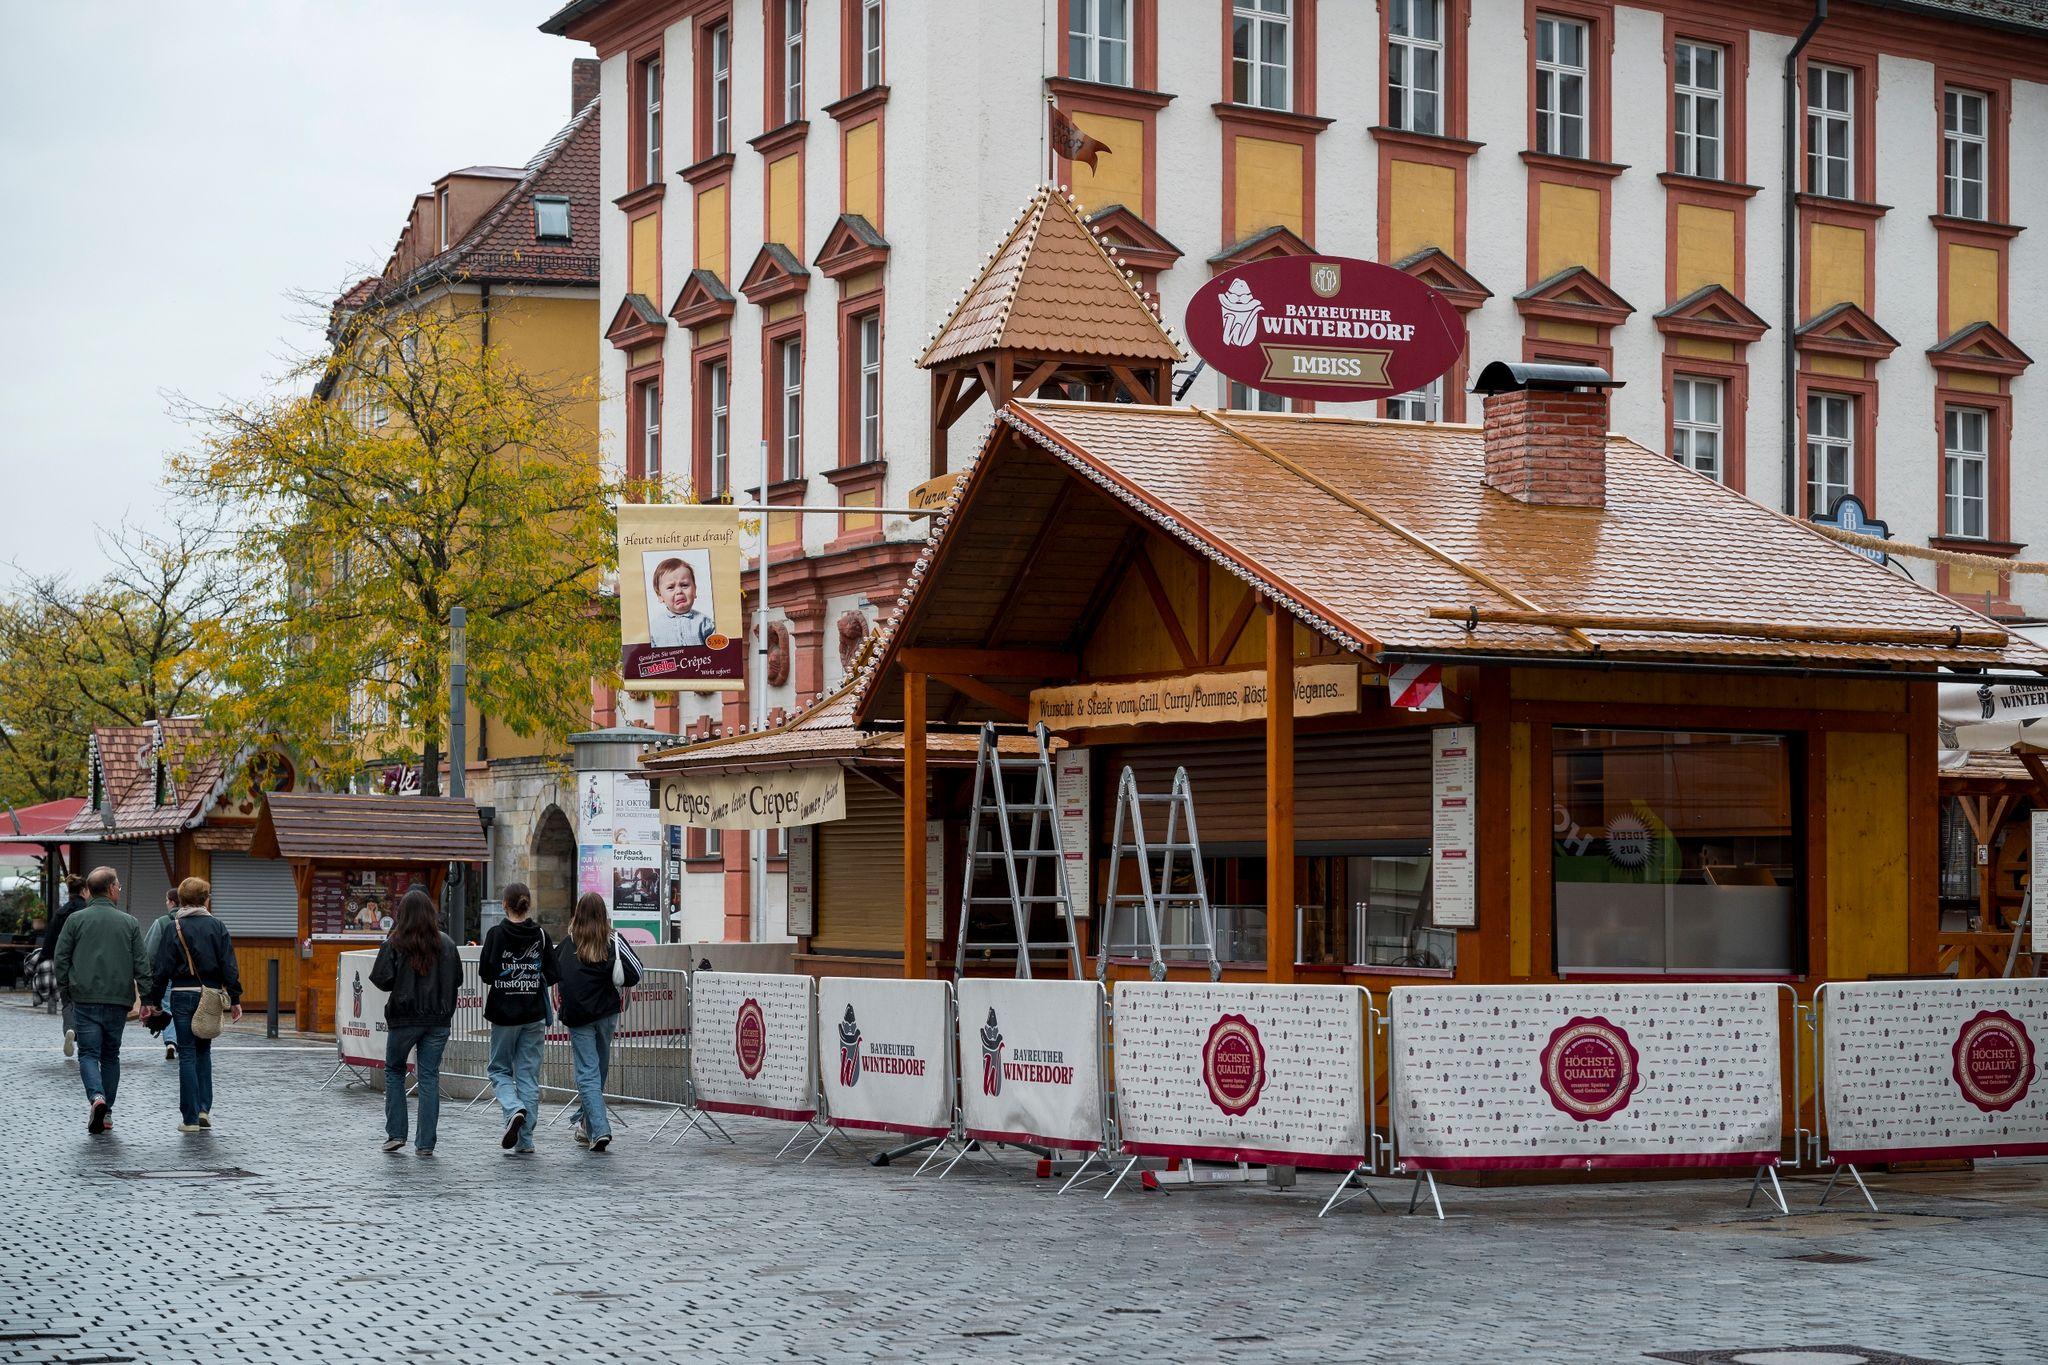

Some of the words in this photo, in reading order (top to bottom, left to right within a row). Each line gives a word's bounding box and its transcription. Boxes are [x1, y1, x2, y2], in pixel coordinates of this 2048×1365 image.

[1285, 304, 1391, 322] BAYREUTHER
[1261, 316, 1416, 341] WINTERDORF
[1292, 356, 1361, 377] IMBISS
[624, 532, 653, 545] Heute
[656, 530, 680, 544] nicht
[683, 533, 701, 547] gut
[702, 529, 734, 545] drauf?
[1040, 701, 1074, 717] Wurscht
[1077, 699, 1084, 715] &
[1087, 697, 1113, 716] Steak
[1116, 699, 1136, 714] vom
[1138, 693, 1161, 712] Grill,
[1164, 690, 1240, 713] Curry/Pommes,
[665, 784, 710, 823] Crêpes
[750, 785, 799, 824] Crêpes
[501, 960, 538, 970] Universe
[870, 1043, 915, 1056] BAYREUTHER
[1013, 1049, 1064, 1063] BAYREUTHER
[1972, 1047, 2015, 1059] HÖCHSTE
[1217, 1051, 1250, 1063] HÖCHSTE
[1564, 1055, 1615, 1067] HÖCHSTE
[862, 1056, 926, 1076] WINTERDORF
[1217, 1063, 1250, 1075] QUALITÄT
[1972, 1059, 2016, 1072] QUALITÄT
[1003, 1063, 1074, 1085] WINTERDORF
[1564, 1067, 1616, 1080] QUALITÄT
